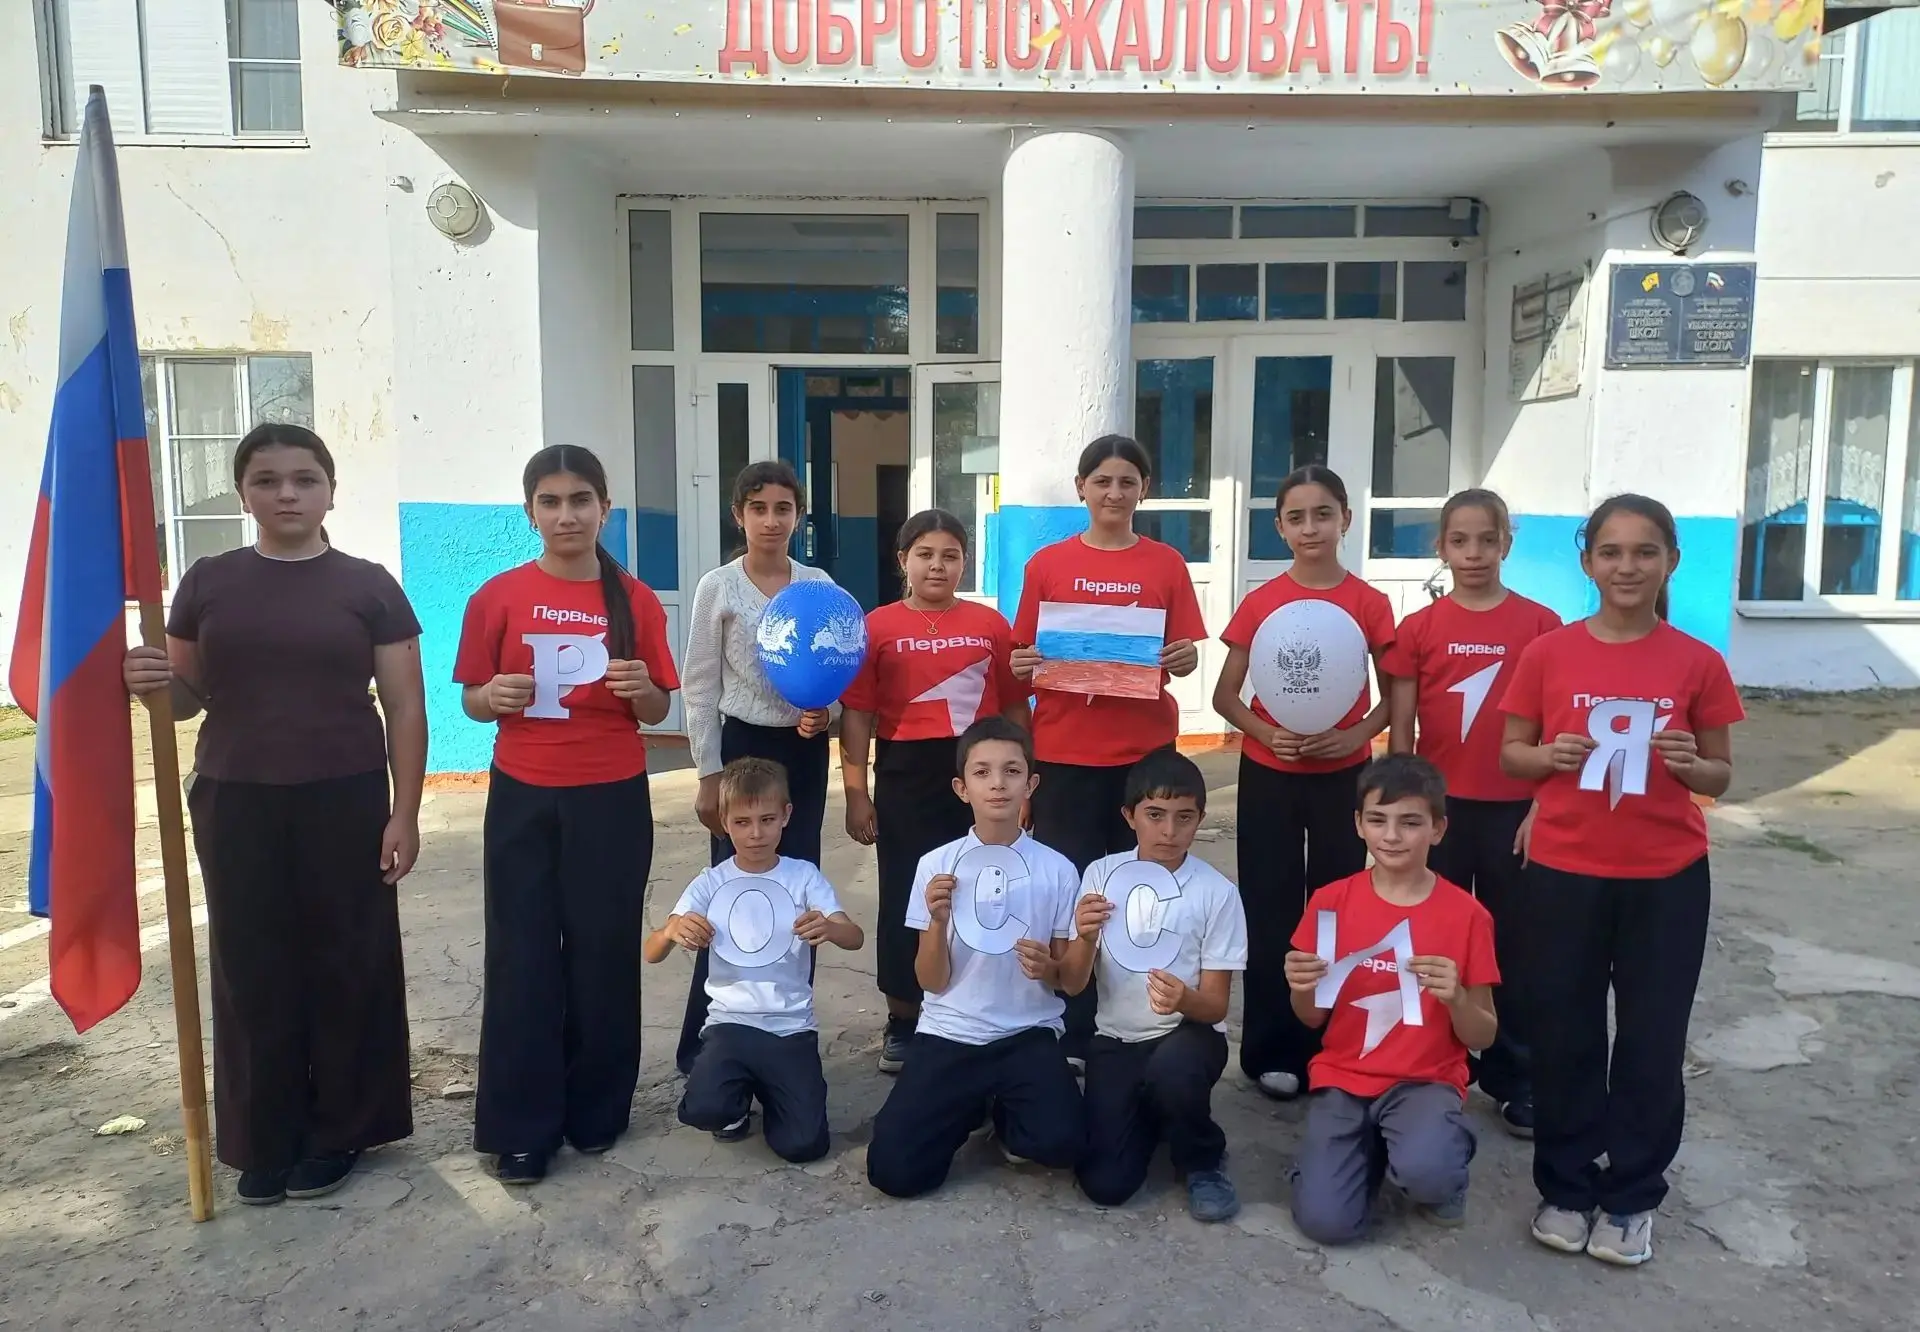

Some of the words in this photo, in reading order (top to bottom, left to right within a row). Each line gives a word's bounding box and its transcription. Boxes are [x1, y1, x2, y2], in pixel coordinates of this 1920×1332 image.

[718, 0, 938, 75] ДОБРО
[959, 0, 1434, 75] ПОЖАЛОВАТЬ!
[1073, 577, 1142, 597] Первые
[532, 605, 609, 626] Первые
[896, 636, 993, 655] Первые
[1447, 642, 1506, 658] Первые
[1282, 686, 1320, 694] РОССИЯ
[1578, 698, 1657, 796] Я
